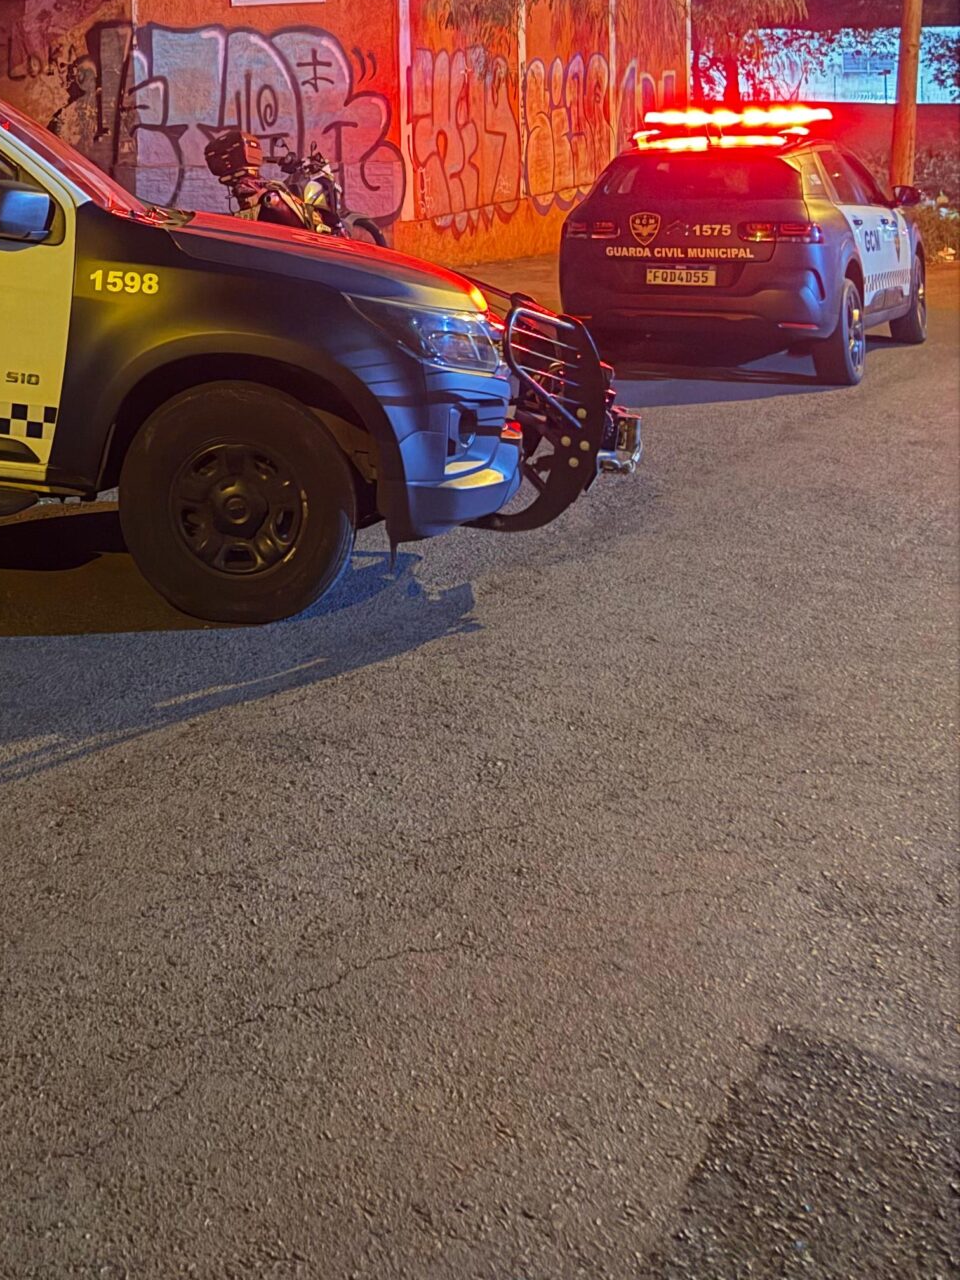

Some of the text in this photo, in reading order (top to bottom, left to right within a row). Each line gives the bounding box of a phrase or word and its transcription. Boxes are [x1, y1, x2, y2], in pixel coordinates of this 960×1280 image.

[692, 224, 732, 236] 1575
[606, 246, 755, 259] GUARDA CIVIL MUNICIPAL
[90, 270, 159, 295] 1598
[5, 371, 40, 386] S10
